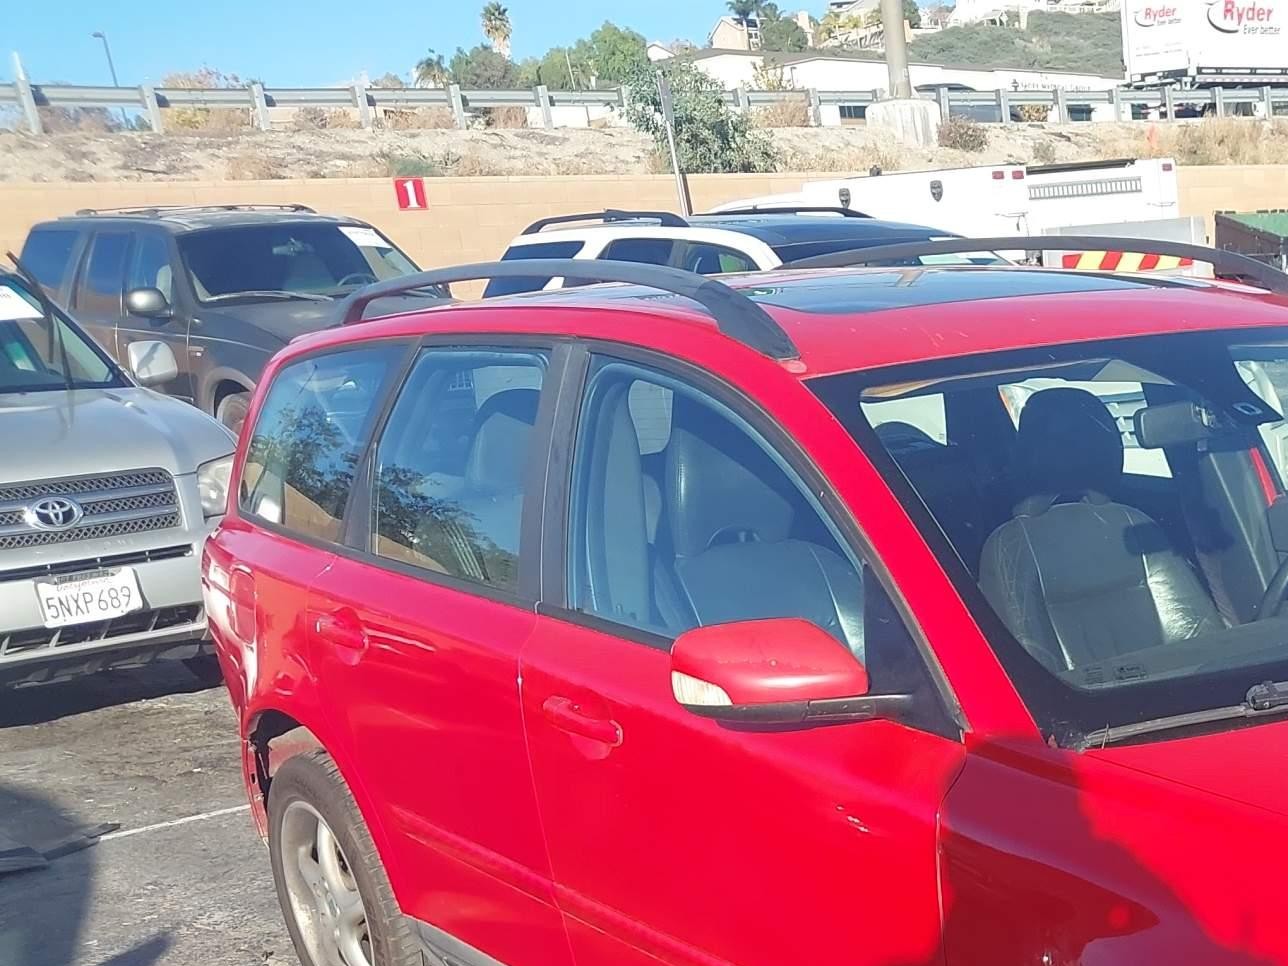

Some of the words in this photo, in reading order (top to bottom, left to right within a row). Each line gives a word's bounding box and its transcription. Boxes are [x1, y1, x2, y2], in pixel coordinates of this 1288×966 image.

[1144, 5, 1177, 21] Ryder
[1224, 0, 1273, 26] Ryder
[1243, 24, 1259, 35] Ever
[402, 180, 422, 208] 1
[46, 586, 131, 619] 5NXP689
